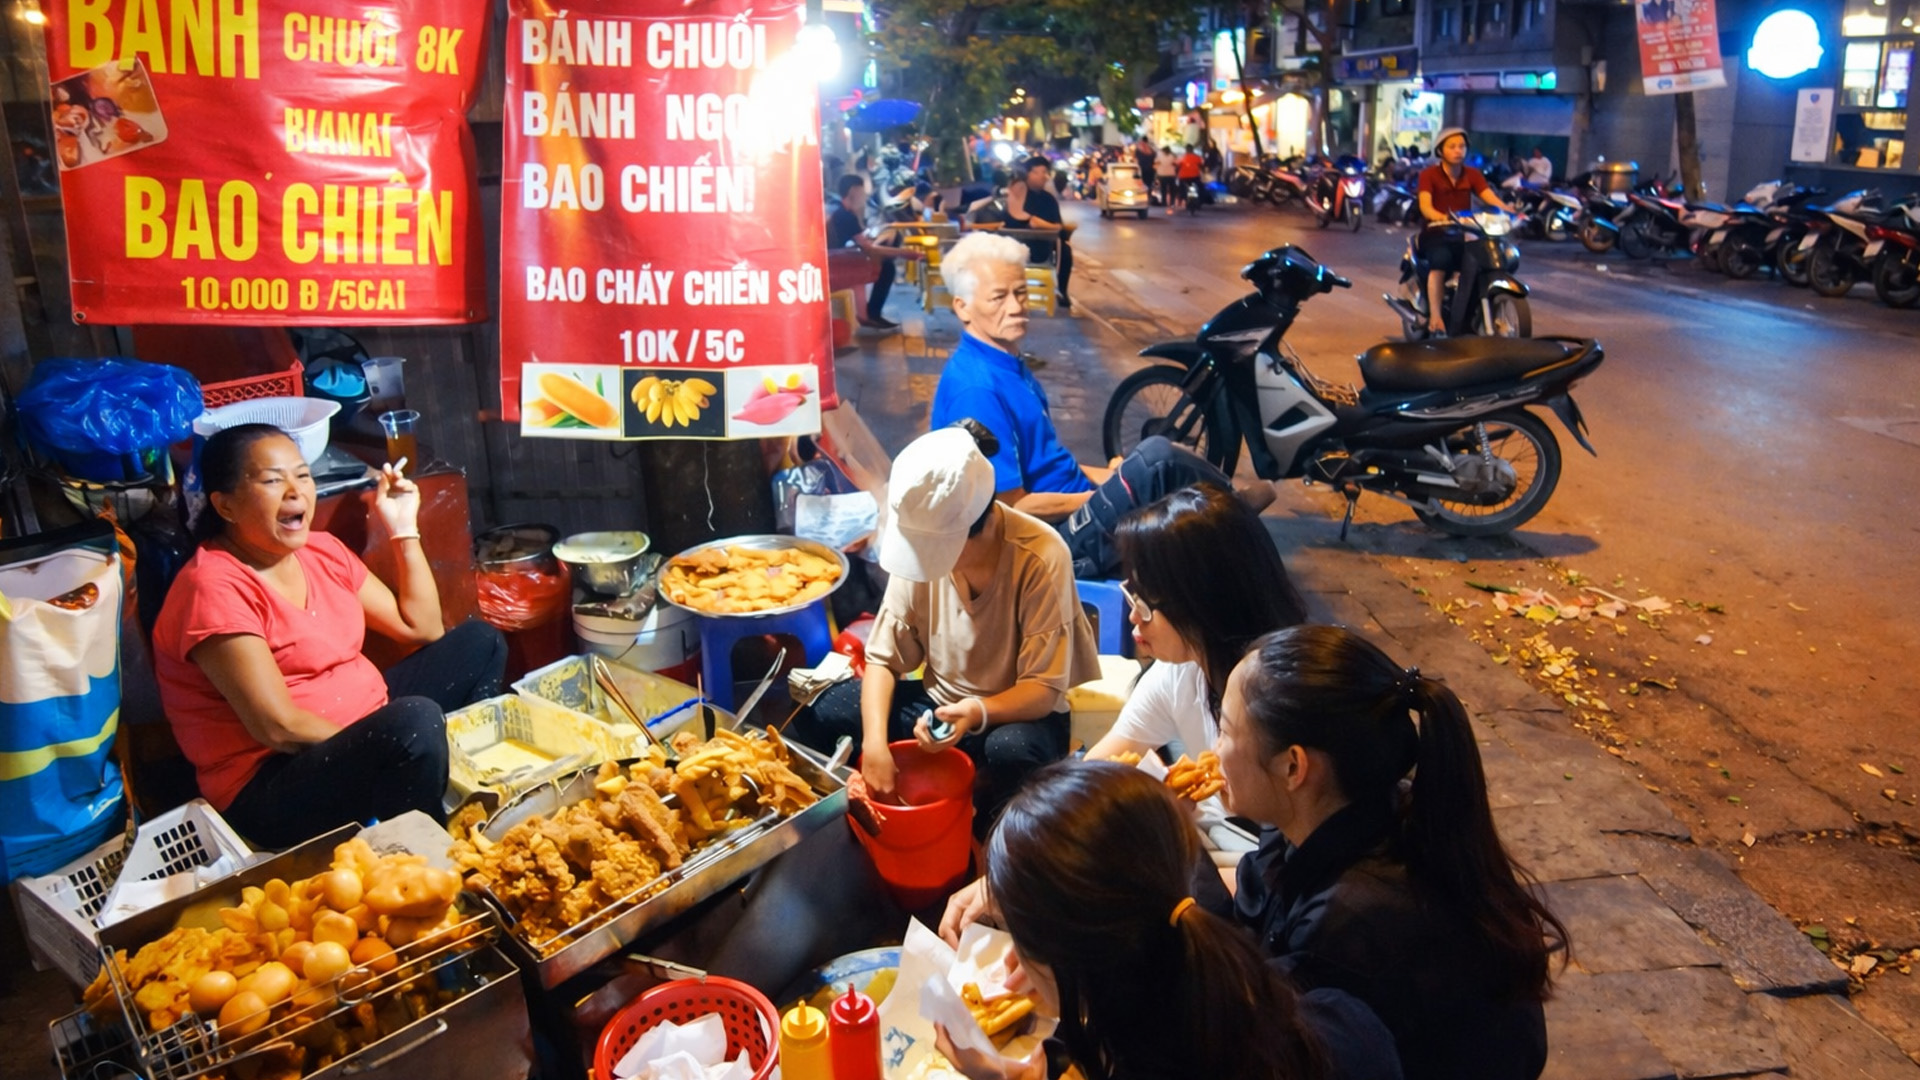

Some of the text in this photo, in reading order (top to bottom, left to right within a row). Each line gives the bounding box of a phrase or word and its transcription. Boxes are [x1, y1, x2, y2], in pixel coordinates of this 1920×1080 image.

[415, 25, 464, 75] 8K
[522, 8, 767, 70] BÁNH CHUỐI
[522, 82, 635, 139] BÁNH
[522, 163, 605, 212] BAO
[181, 276, 289, 311] 10.000
[526, 265, 587, 302] BAO
[619, 329, 680, 364] 10K
[705, 330, 745, 363] 5C
